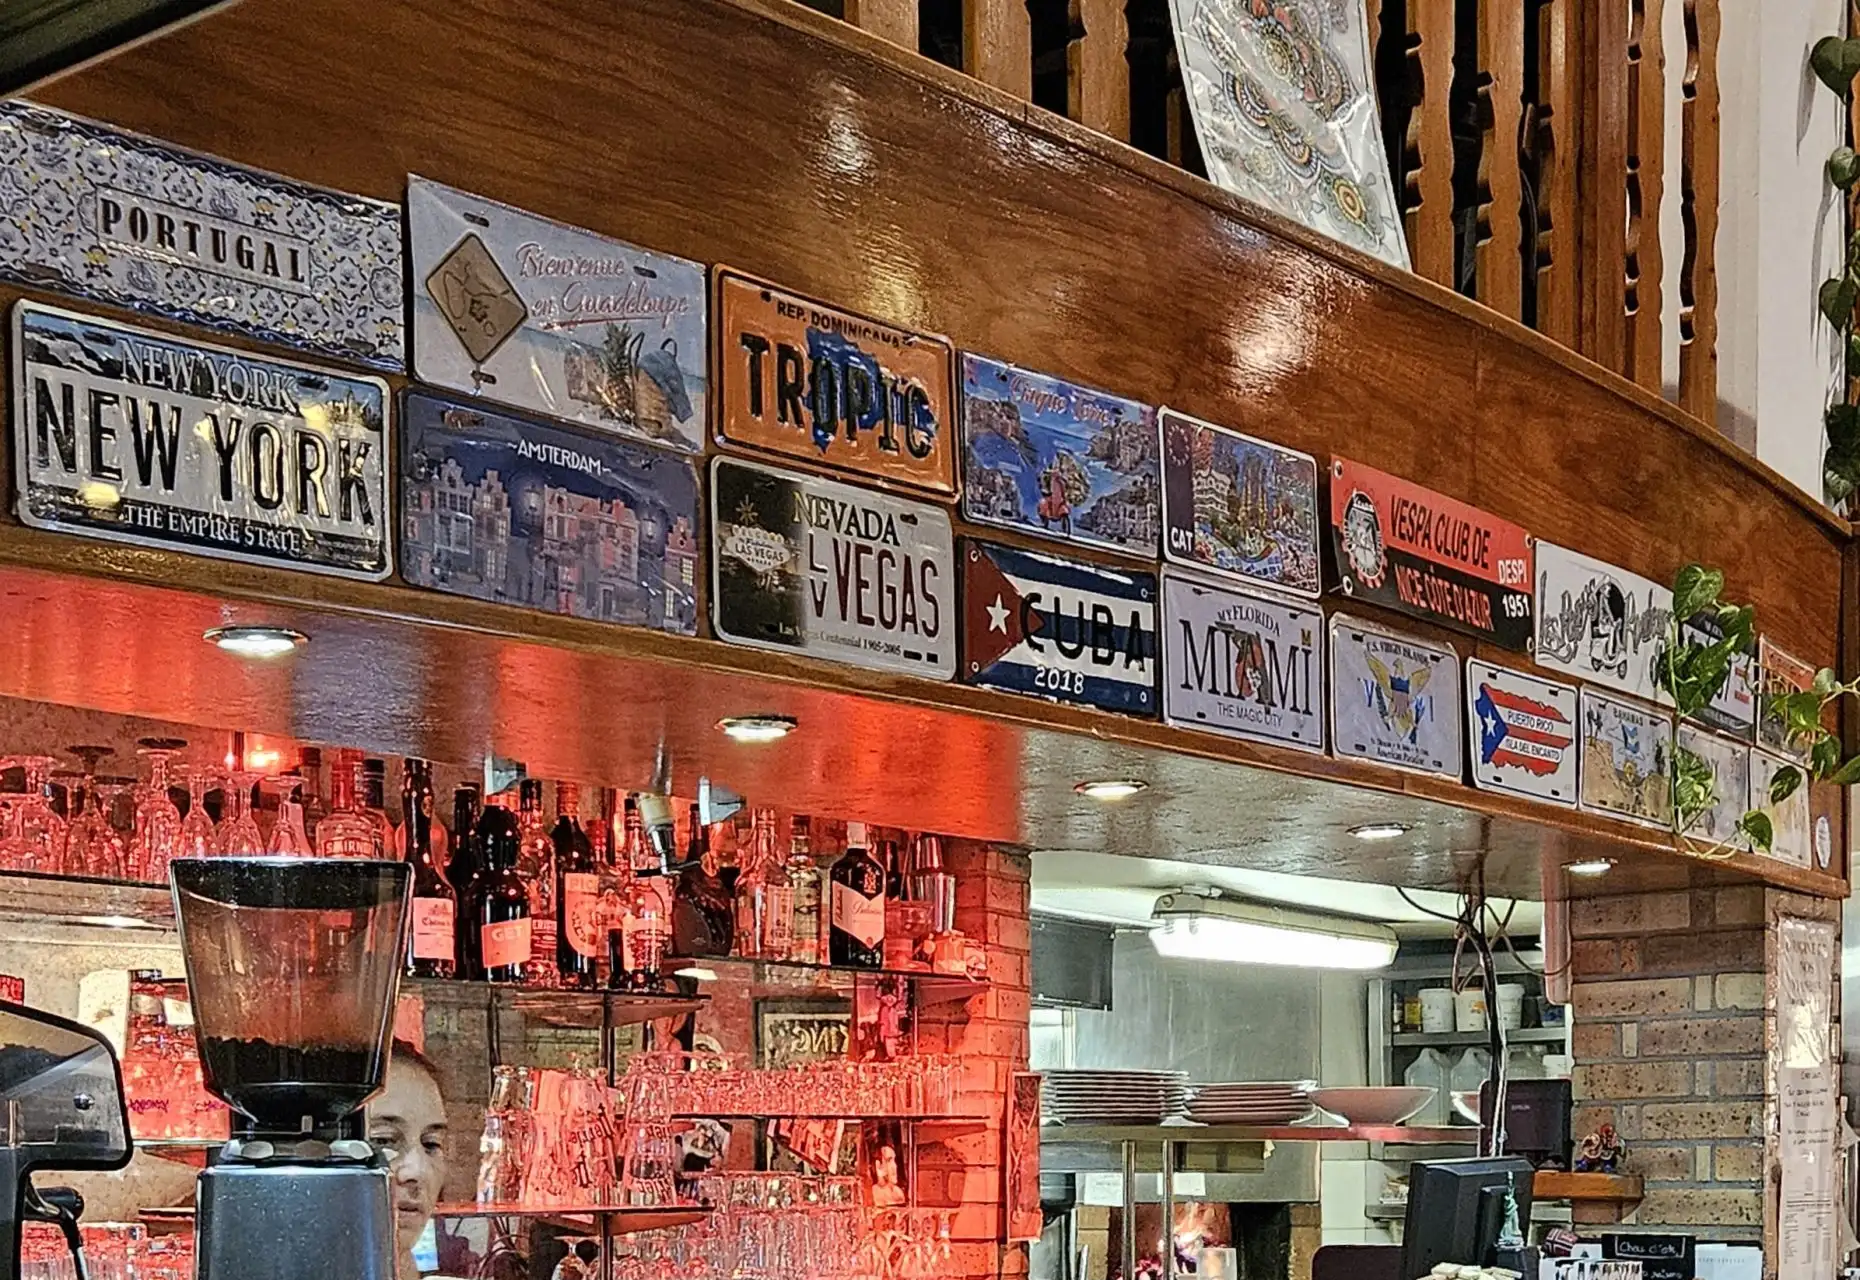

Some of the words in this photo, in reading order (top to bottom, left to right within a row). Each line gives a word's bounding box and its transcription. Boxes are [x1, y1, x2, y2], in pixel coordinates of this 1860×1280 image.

[102, 198, 306, 283] PORTUGAL
[515, 242, 625, 278] Bienvenue
[532, 299, 552, 316] en
[560, 281, 689, 328] Guadeloupe
[777, 302, 806, 322] REP.
[121, 338, 199, 396] NEW
[202, 356, 298, 413] YORK
[740, 332, 933, 461] TROPIC
[34, 377, 183, 491] NEW
[206, 413, 375, 526] YORK
[517, 439, 602, 475] AMSTERDAM
[124, 503, 163, 530] THE
[168, 510, 240, 544] EMPIRE
[244, 525, 301, 554] STATE
[793, 491, 900, 547] NEVADA
[1171, 526, 1193, 552] CAT
[1390, 494, 1433, 550] VESPA
[1434, 513, 1470, 562] CLUB
[1472, 527, 1491, 570] DE
[735, 543, 752, 555] LAS
[753, 547, 784, 562] VEGAS
[833, 537, 940, 639] VEGAS
[1394, 563, 1427, 608] NICE
[1502, 594, 1530, 618] 1951
[1020, 592, 1146, 672] CUBA
[1034, 664, 1084, 694] 2018
[1178, 618, 1313, 716] MIAMI
[1217, 702, 1234, 719] THE
[1236, 706, 1262, 723] MAGIC
[1263, 711, 1283, 728] CITY
[1508, 710, 1536, 728] PUERTO
[1536, 718, 1554, 733] RICO
